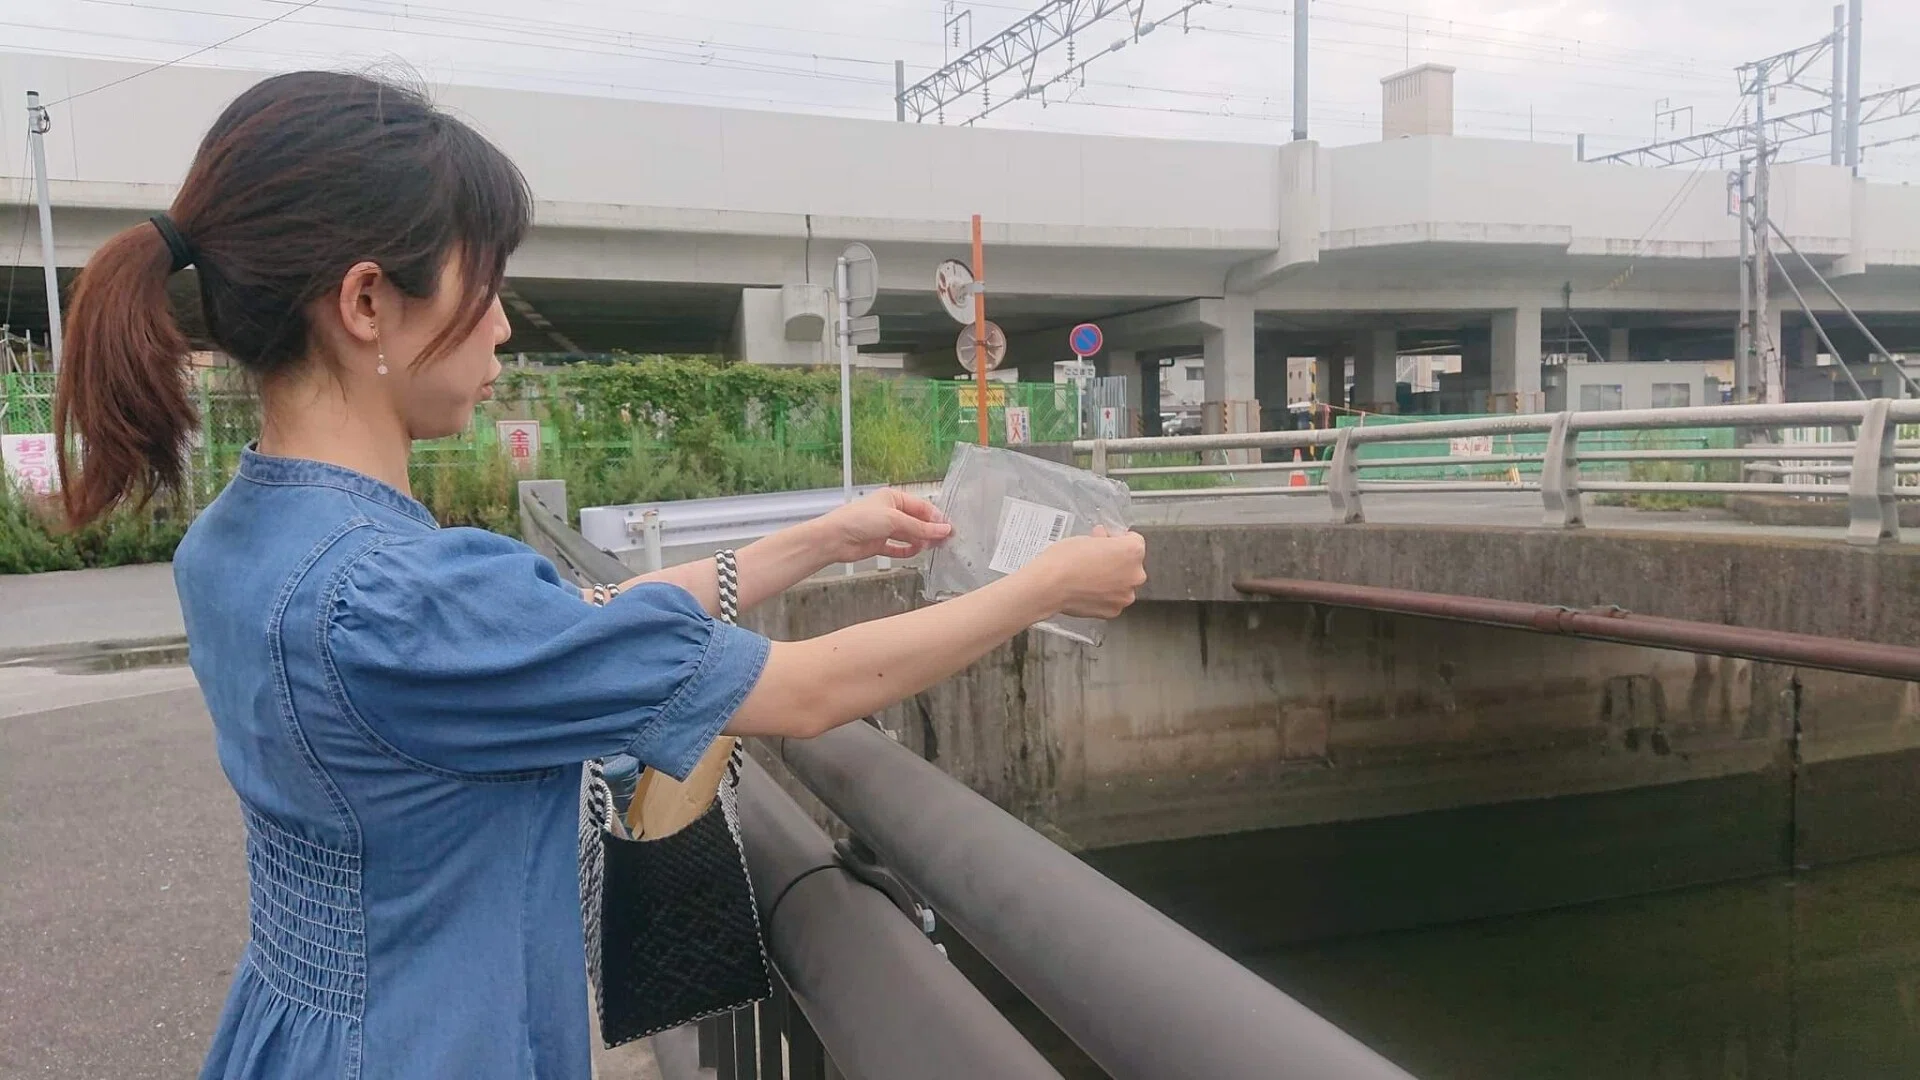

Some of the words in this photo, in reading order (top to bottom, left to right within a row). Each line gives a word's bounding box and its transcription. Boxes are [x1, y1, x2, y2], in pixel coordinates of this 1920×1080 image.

[1065, 368, 1094, 376] ここまで
[1010, 413, 1022, 442] 立入
[509, 429, 530, 458] 全面
